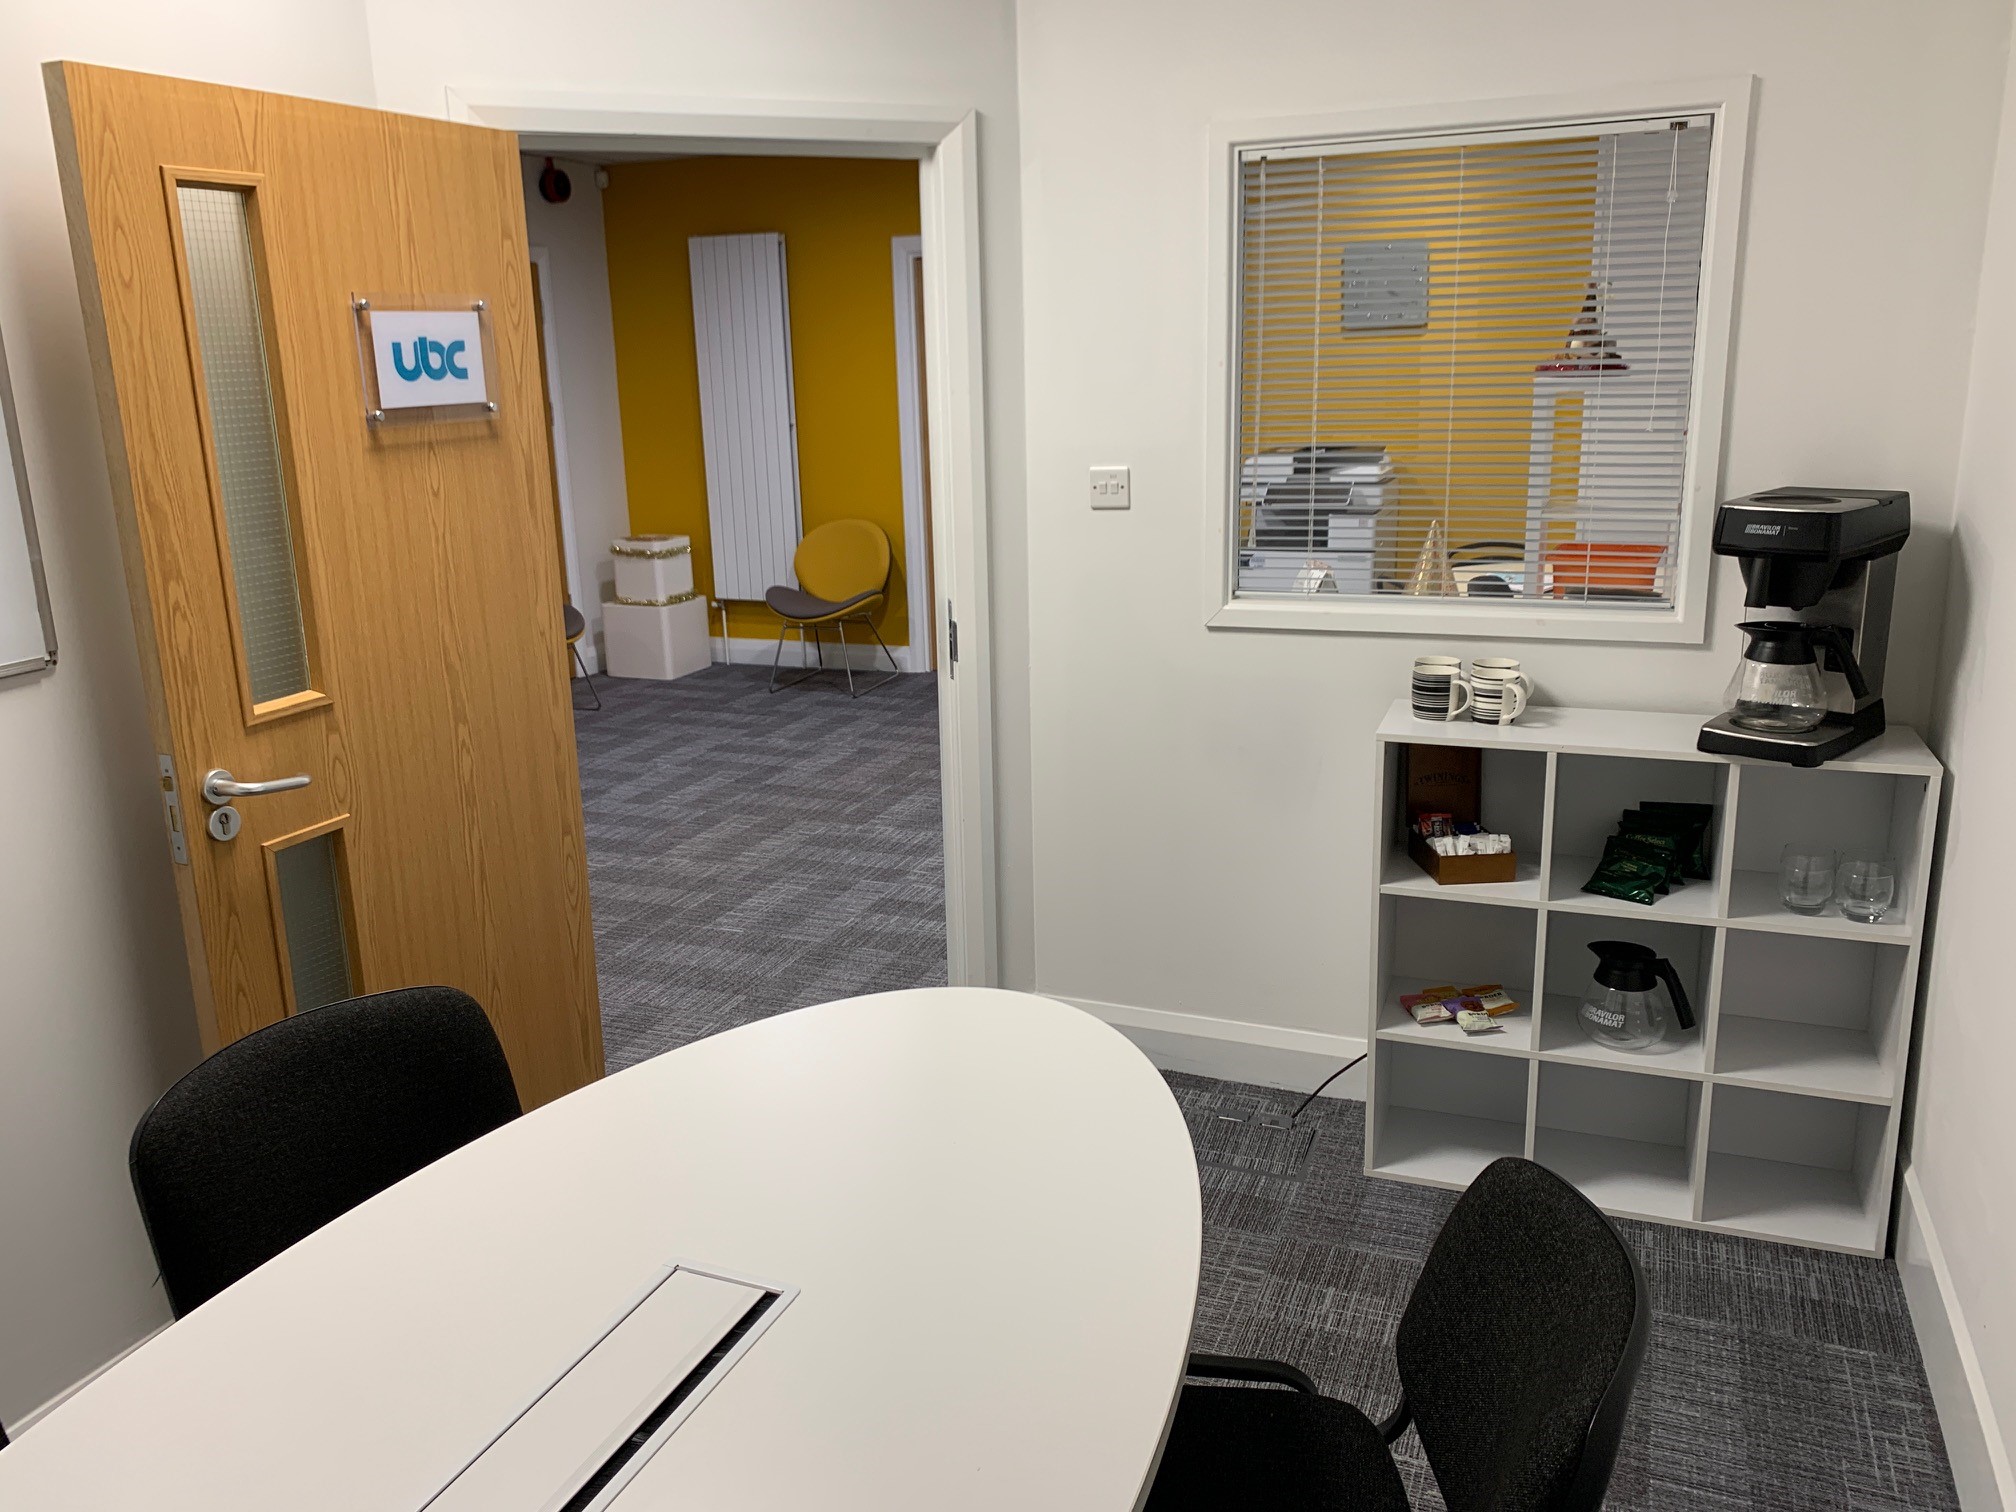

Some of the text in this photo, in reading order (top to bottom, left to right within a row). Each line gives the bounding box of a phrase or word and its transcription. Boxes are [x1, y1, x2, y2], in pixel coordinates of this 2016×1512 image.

[391, 336, 468, 382] ubc
[1585, 1012, 1624, 1028] BONAMAT
[1588, 1005, 1625, 1022] BRAVILOR
